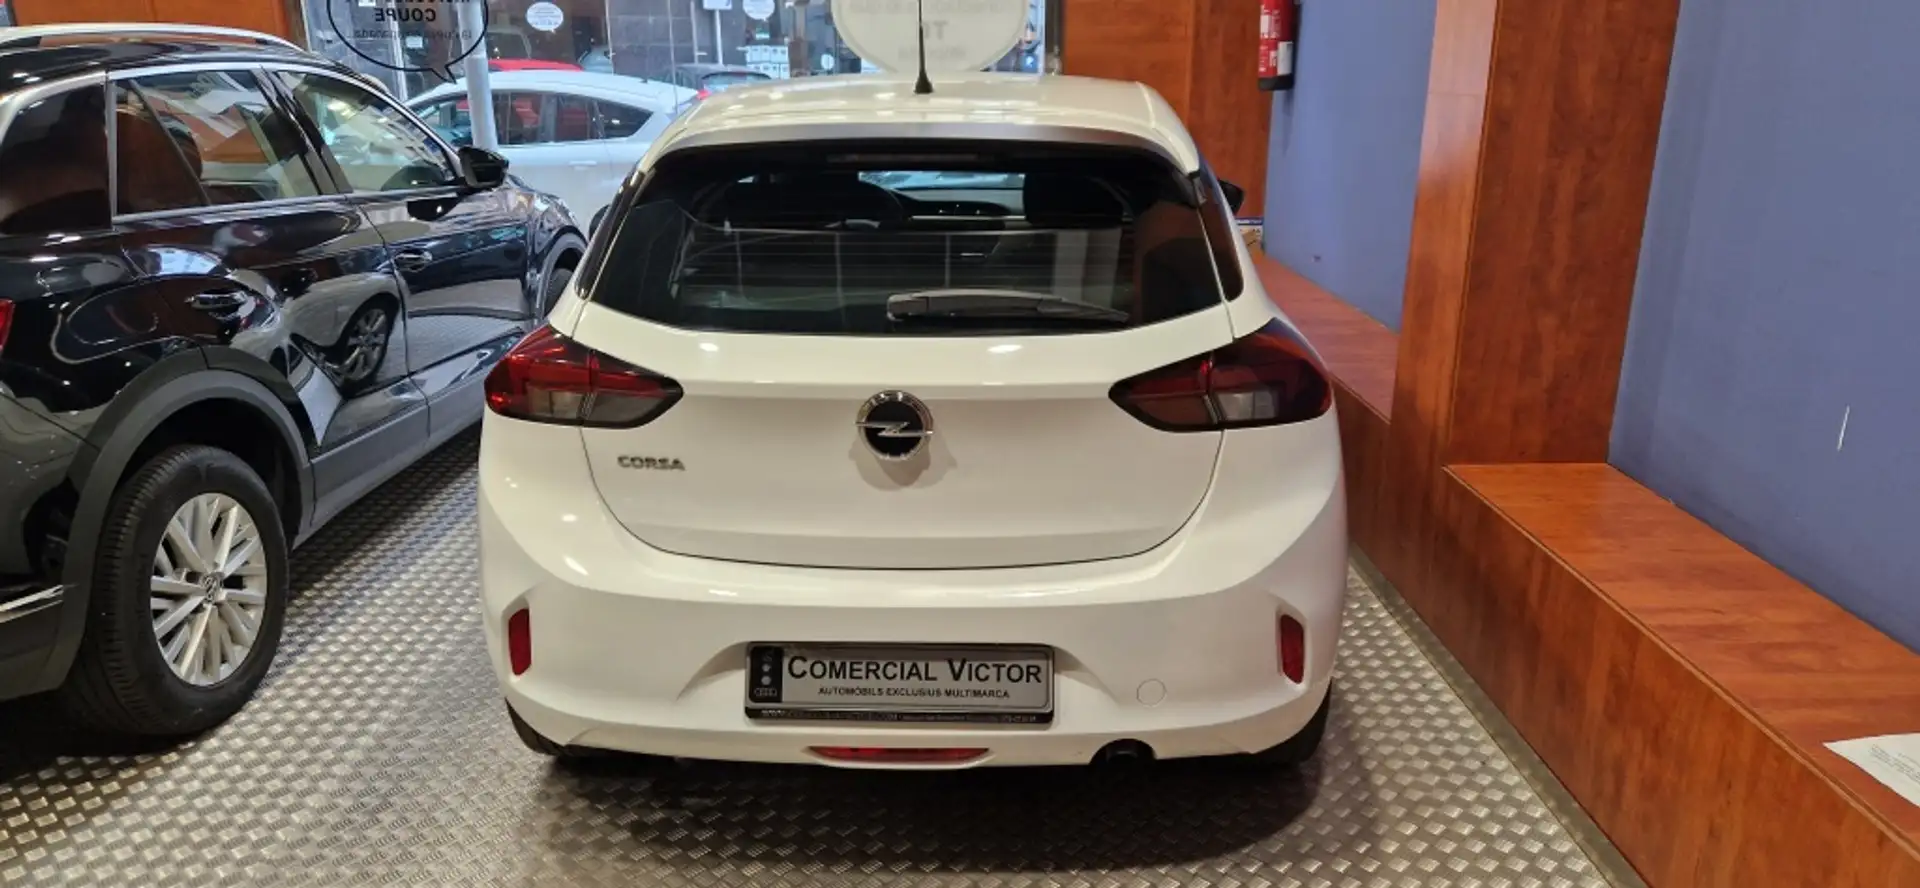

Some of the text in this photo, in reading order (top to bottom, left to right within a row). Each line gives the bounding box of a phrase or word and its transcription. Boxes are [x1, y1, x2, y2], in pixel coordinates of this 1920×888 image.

[617, 455, 686, 471] CORSA
[788, 655, 1042, 683] COMERCIAL VICTOR
[886, 687, 941, 698] EXCLUSIUS
[944, 688, 1010, 699] MULTIMARCA
